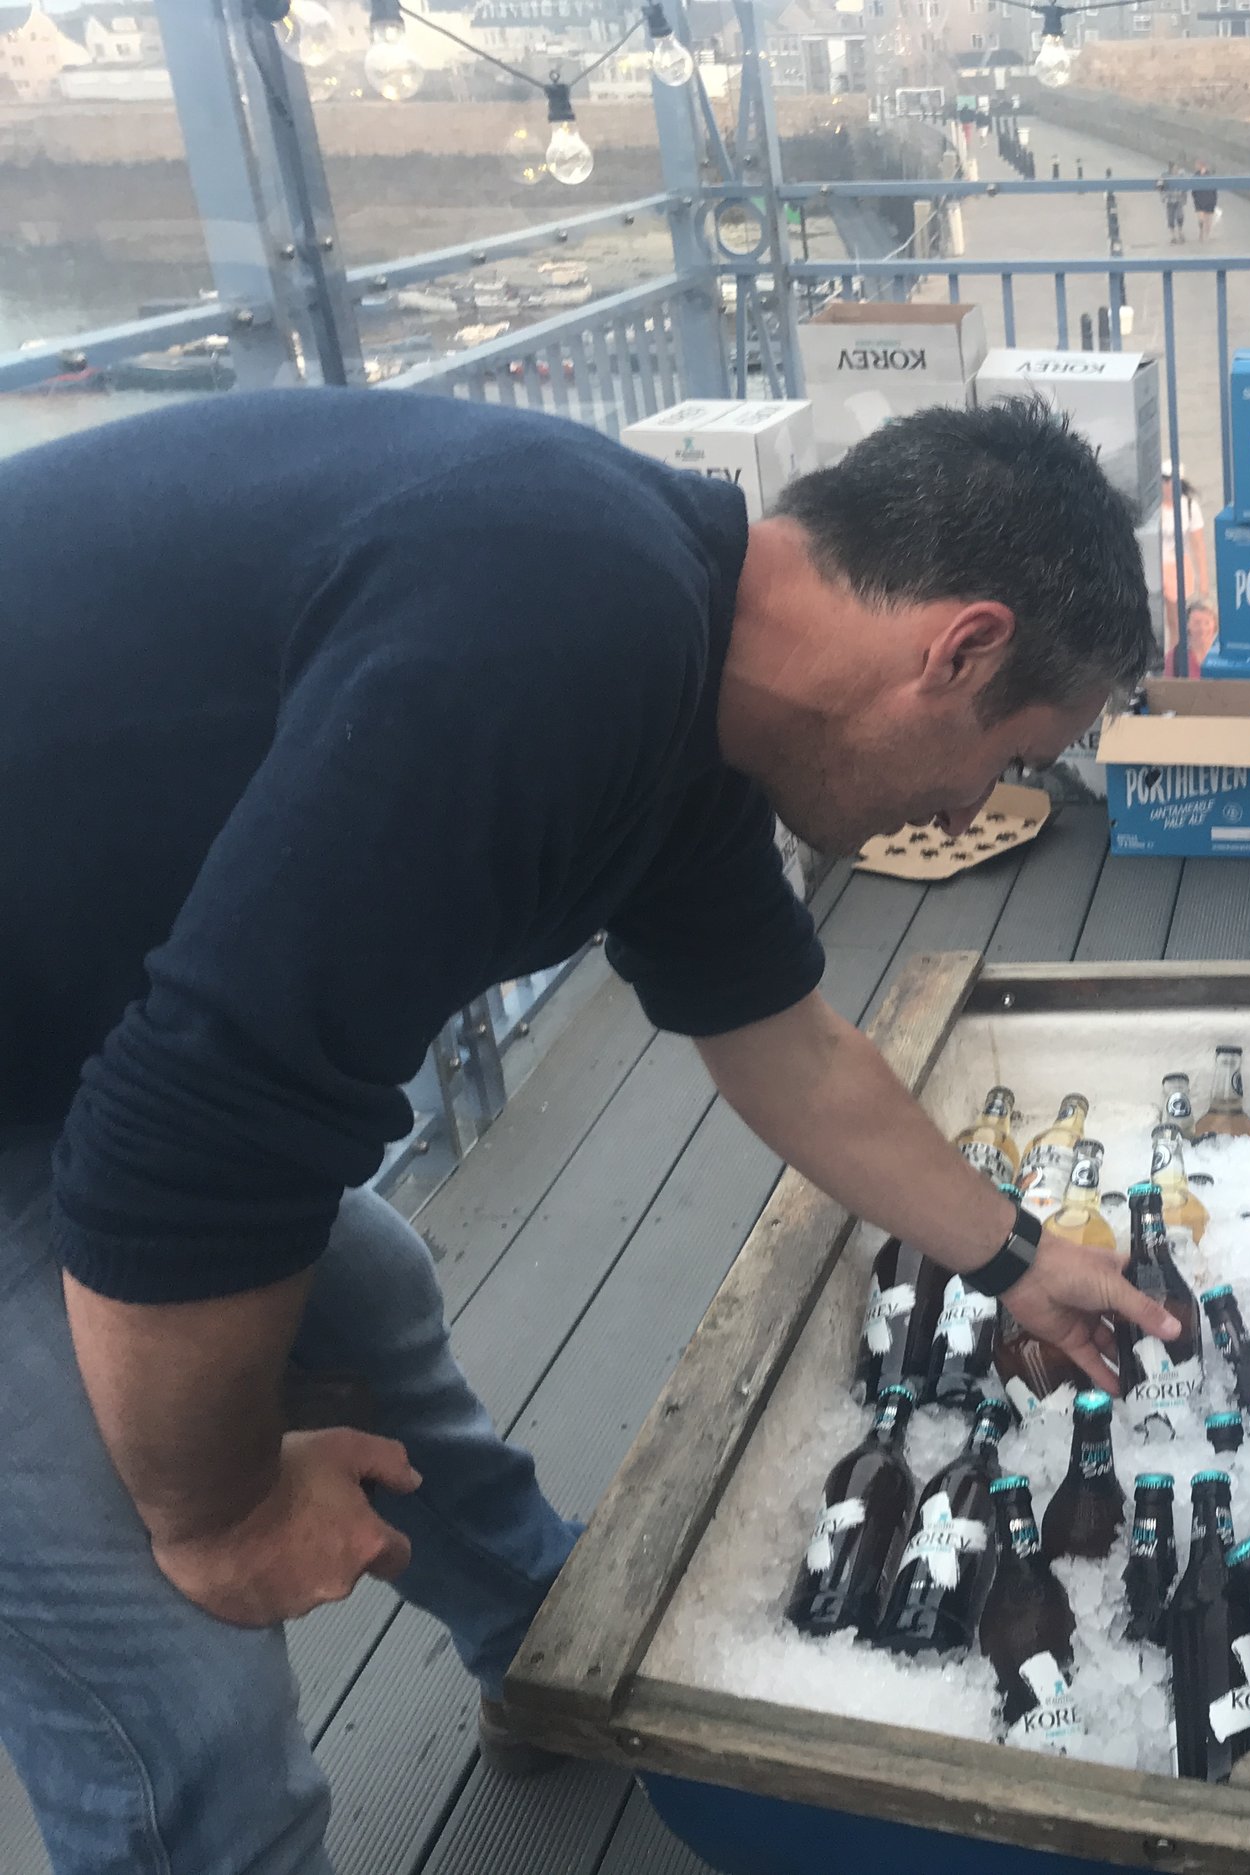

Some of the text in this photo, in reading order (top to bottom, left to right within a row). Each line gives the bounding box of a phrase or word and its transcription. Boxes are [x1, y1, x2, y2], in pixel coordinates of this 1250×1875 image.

[837, 348, 927, 370] KOREV
[1134, 1379, 1195, 1401] KOREV
[1024, 1705, 1081, 1733] KORE
